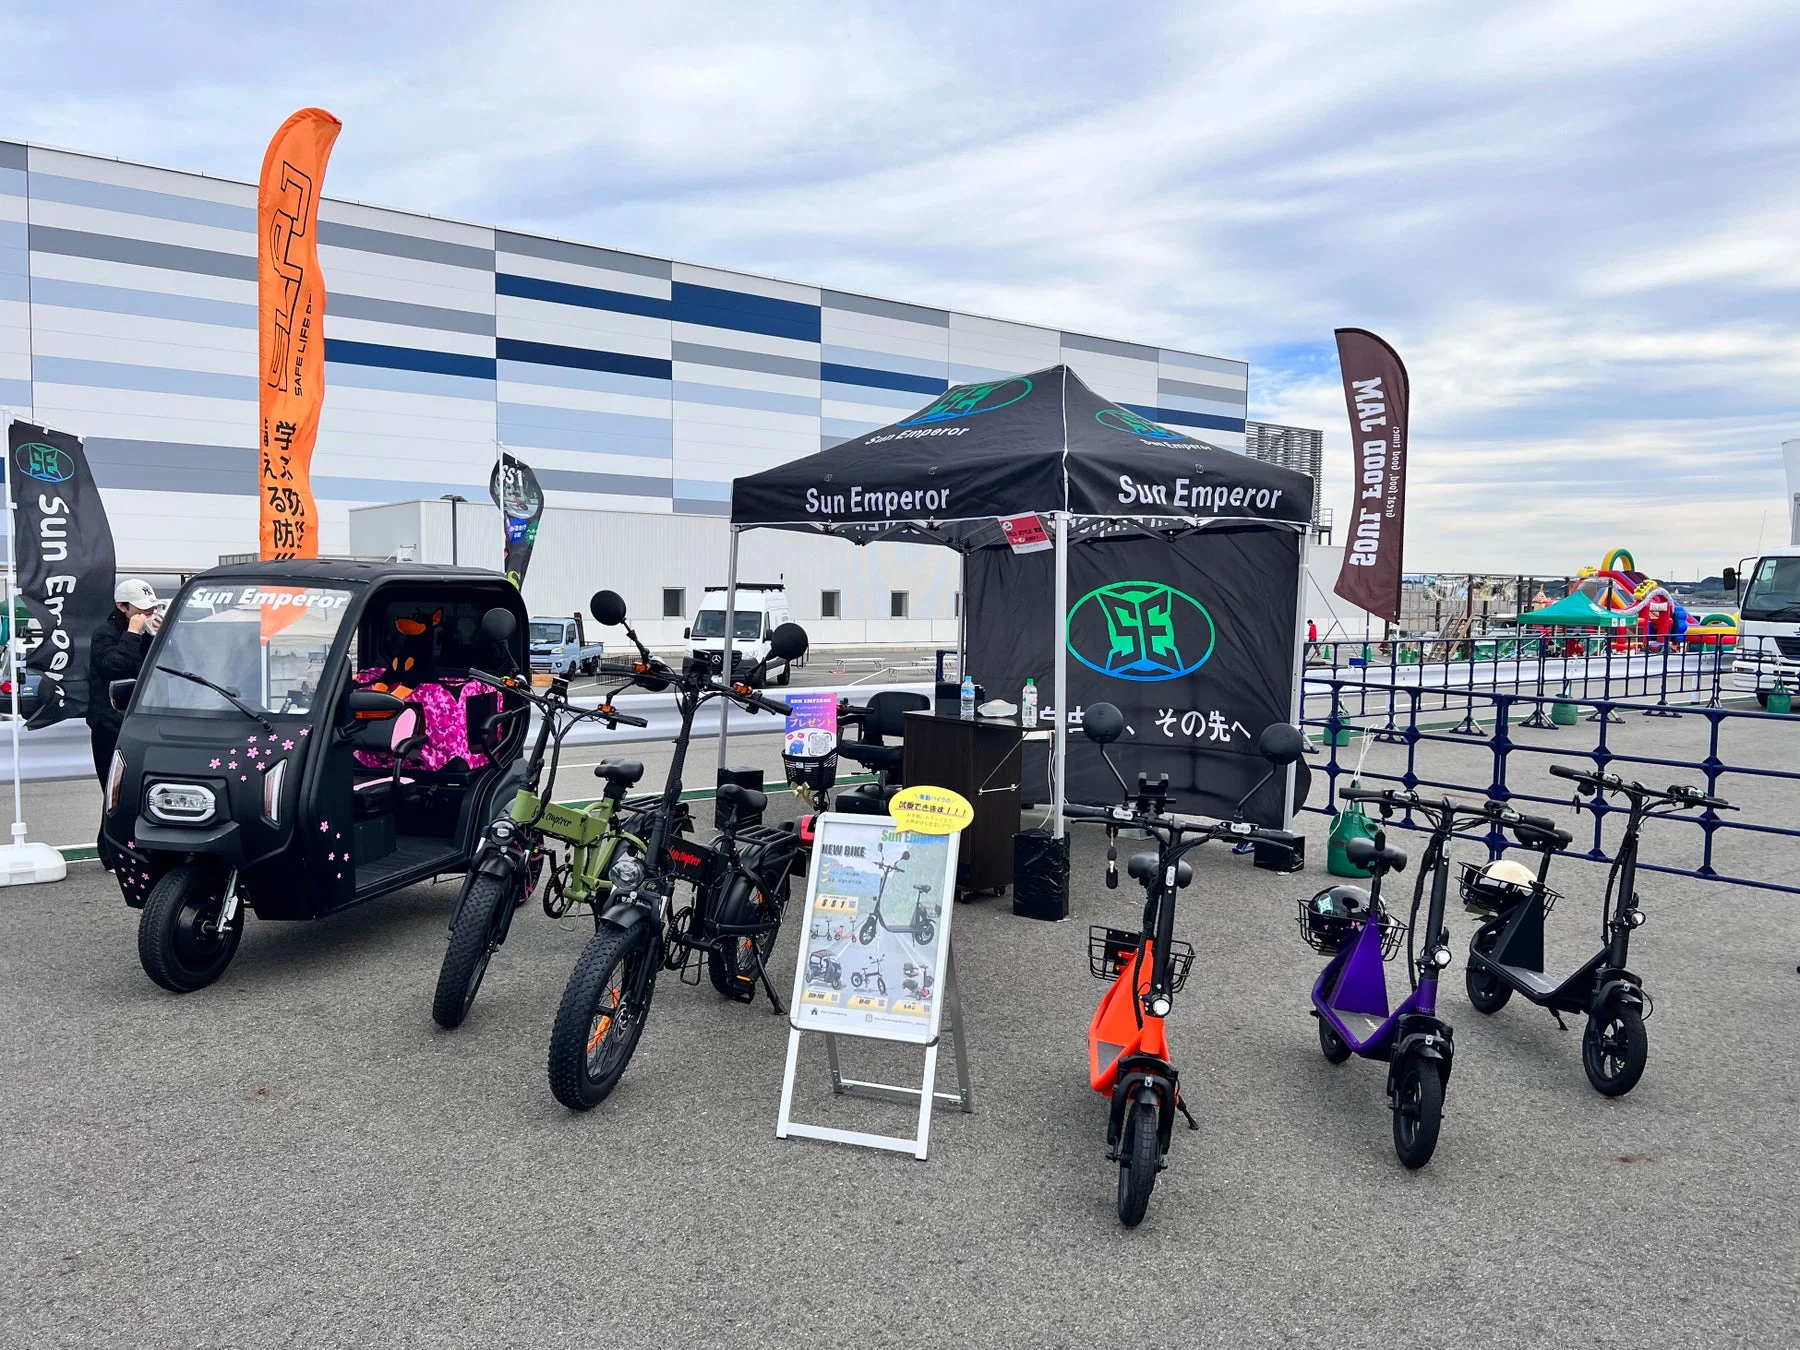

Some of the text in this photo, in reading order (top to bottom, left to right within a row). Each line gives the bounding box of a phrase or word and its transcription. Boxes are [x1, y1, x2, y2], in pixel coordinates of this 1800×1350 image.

[297, 318, 312, 353] LIFE
[294, 356, 304, 397] SAFE
[865, 426, 970, 446] Sun Emperor
[805, 486, 950, 517] Sun Emperor
[1118, 474, 1282, 513] Sun Emperor
[38, 494, 69, 561] Sun
[190, 588, 348, 610] Sun Emperor
[790, 719, 833, 728] プレゼント
[881, 829, 902, 842] Sun
[821, 844, 866, 858] NEW BIKE
